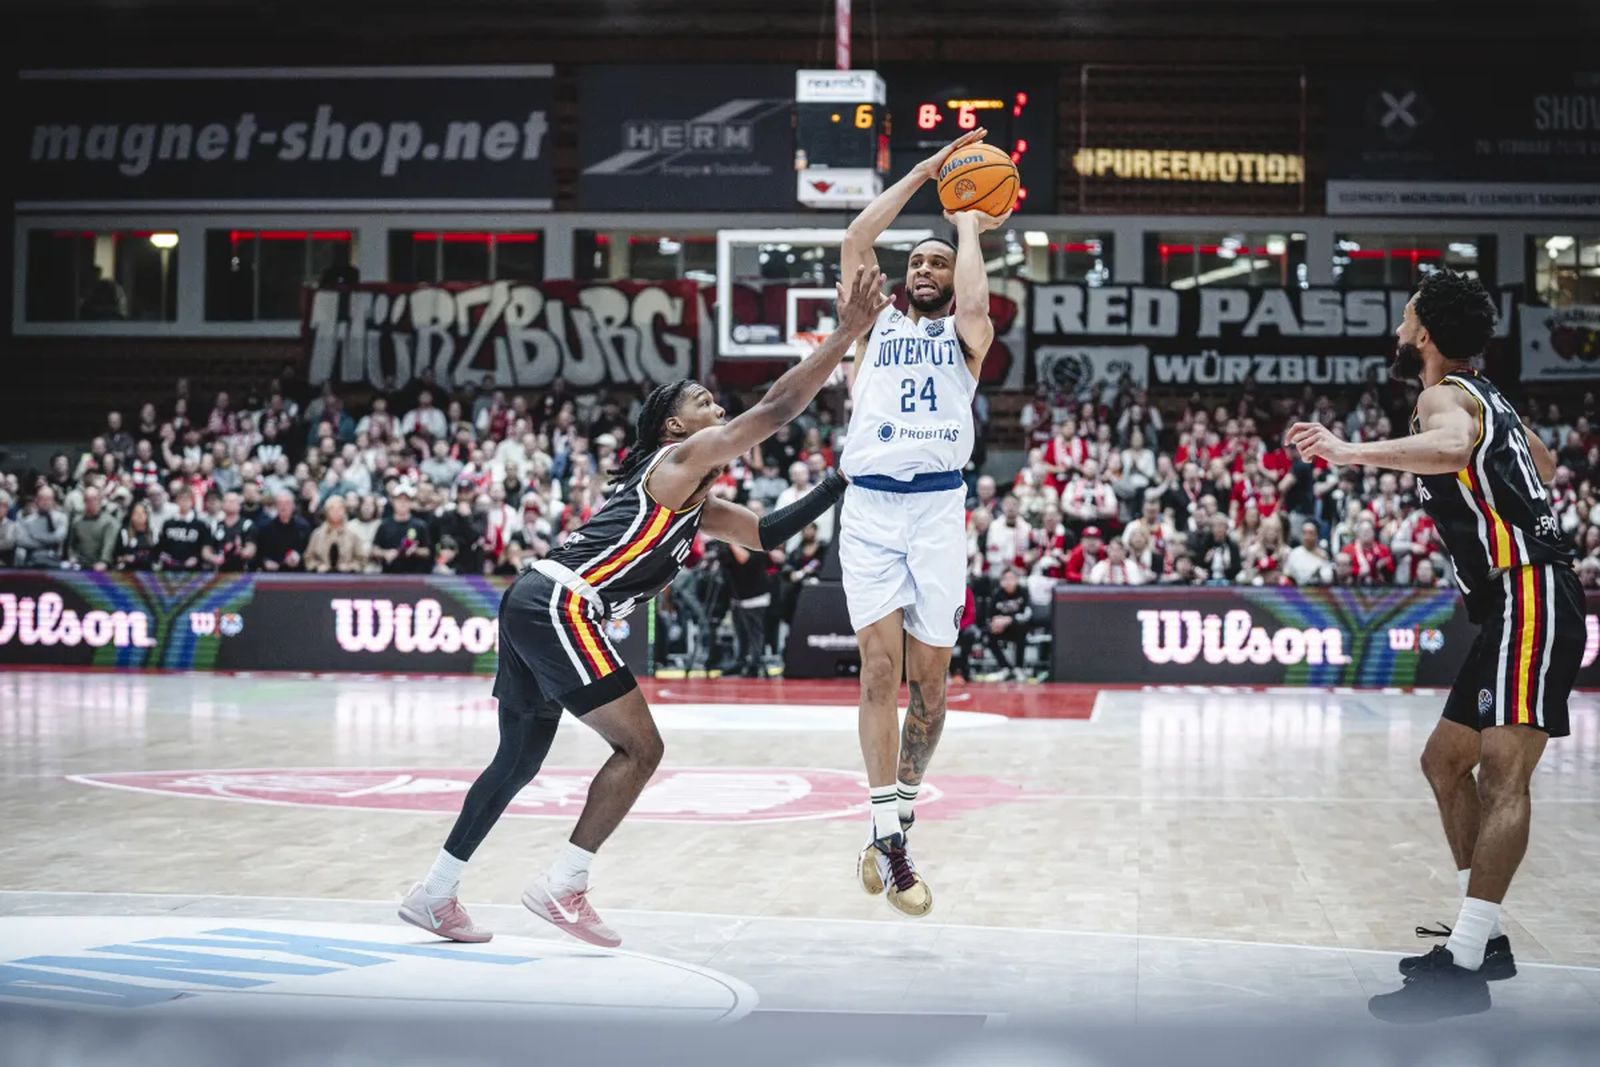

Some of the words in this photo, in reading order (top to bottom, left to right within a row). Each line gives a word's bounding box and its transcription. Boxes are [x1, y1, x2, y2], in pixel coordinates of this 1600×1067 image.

[854, 104, 874, 129] 6
[30, 105, 548, 176] magnet-shop.net
[628, 125, 751, 149] HERM
[939, 153, 985, 182] Wilson
[1033, 285, 1180, 337] RED
[900, 376, 938, 413] 24
[899, 428, 960, 442] PROBITAS
[0, 591, 156, 648] ilson
[1136, 609, 1350, 666] Wilson
